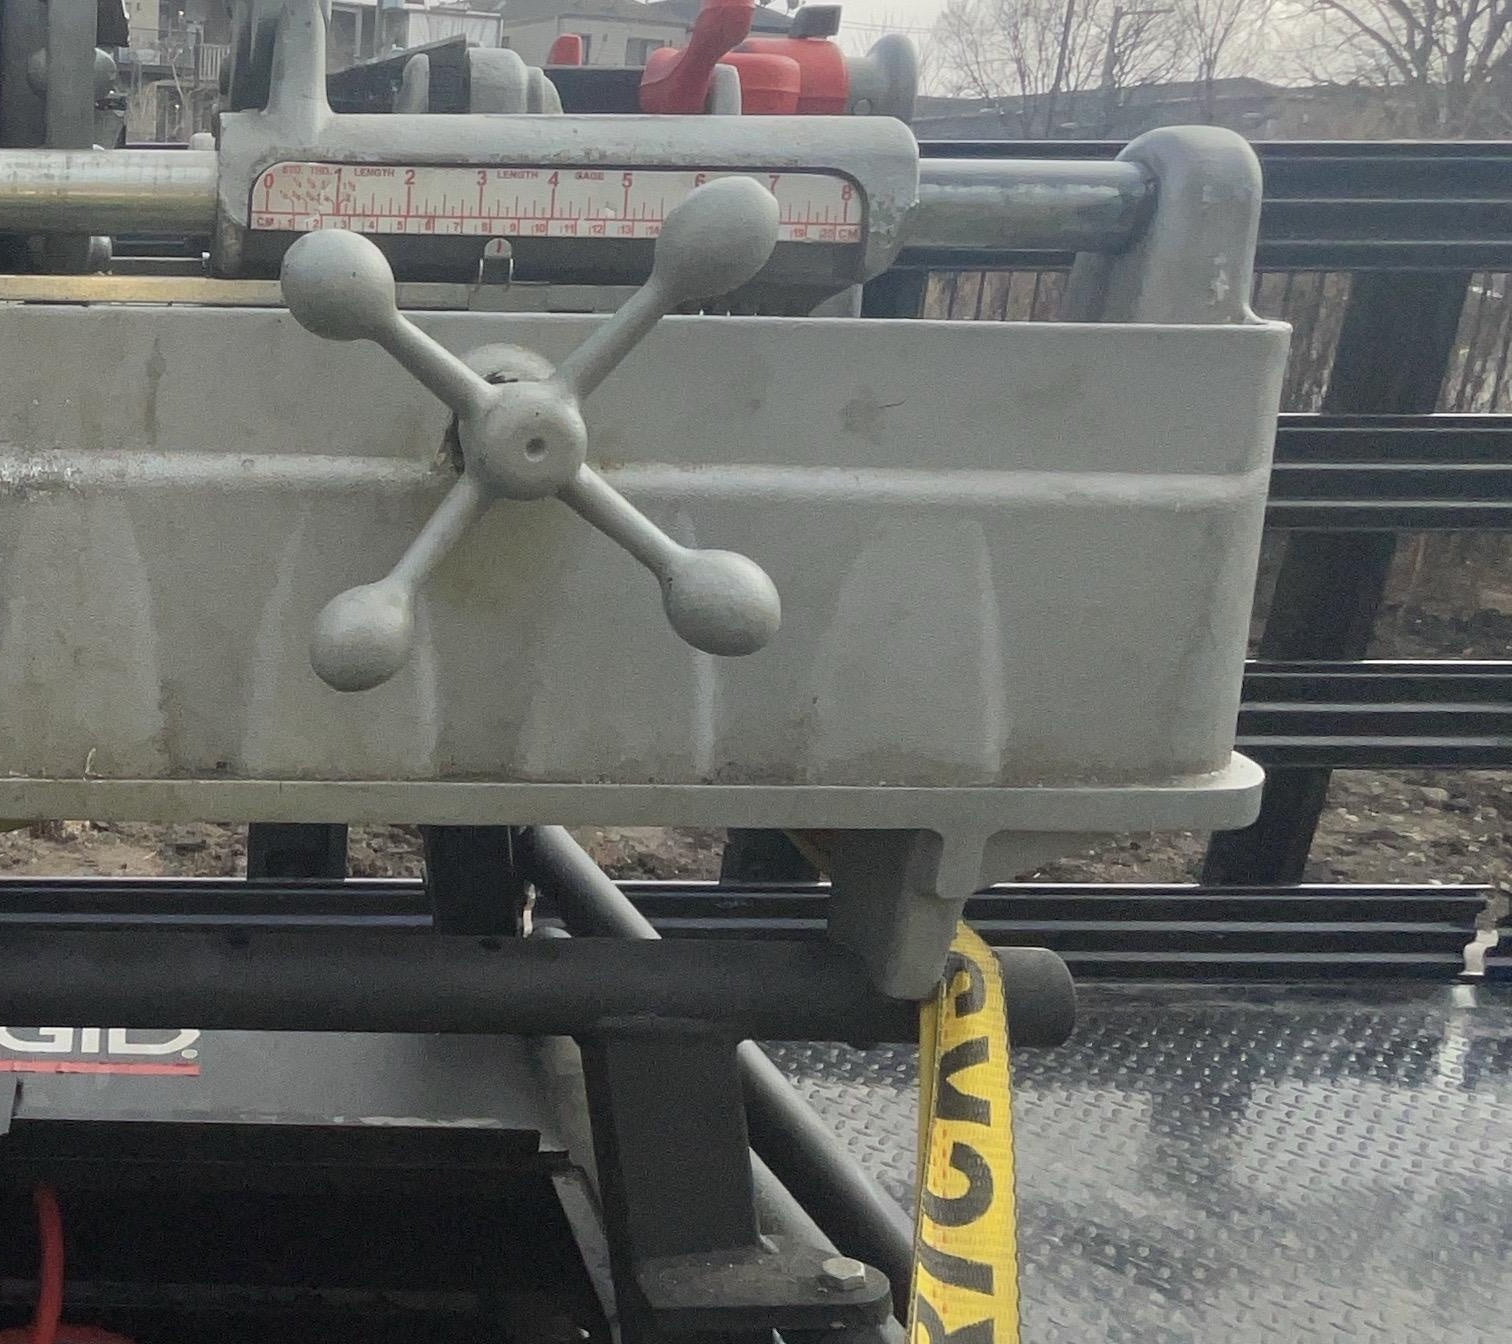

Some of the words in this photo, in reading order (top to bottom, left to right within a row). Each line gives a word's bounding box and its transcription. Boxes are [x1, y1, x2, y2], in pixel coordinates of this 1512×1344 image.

[263, 173, 274, 189] 0
[404, 169, 415, 185] 2
[477, 170, 487, 186] 3
[548, 171, 559, 187] 4
[623, 173, 633, 188] 5
[769, 175, 780, 191] 7
[841, 184, 852, 200] 8
[354, 168, 395, 177] LENGTH
[497, 171, 538, 180] LENGTH
